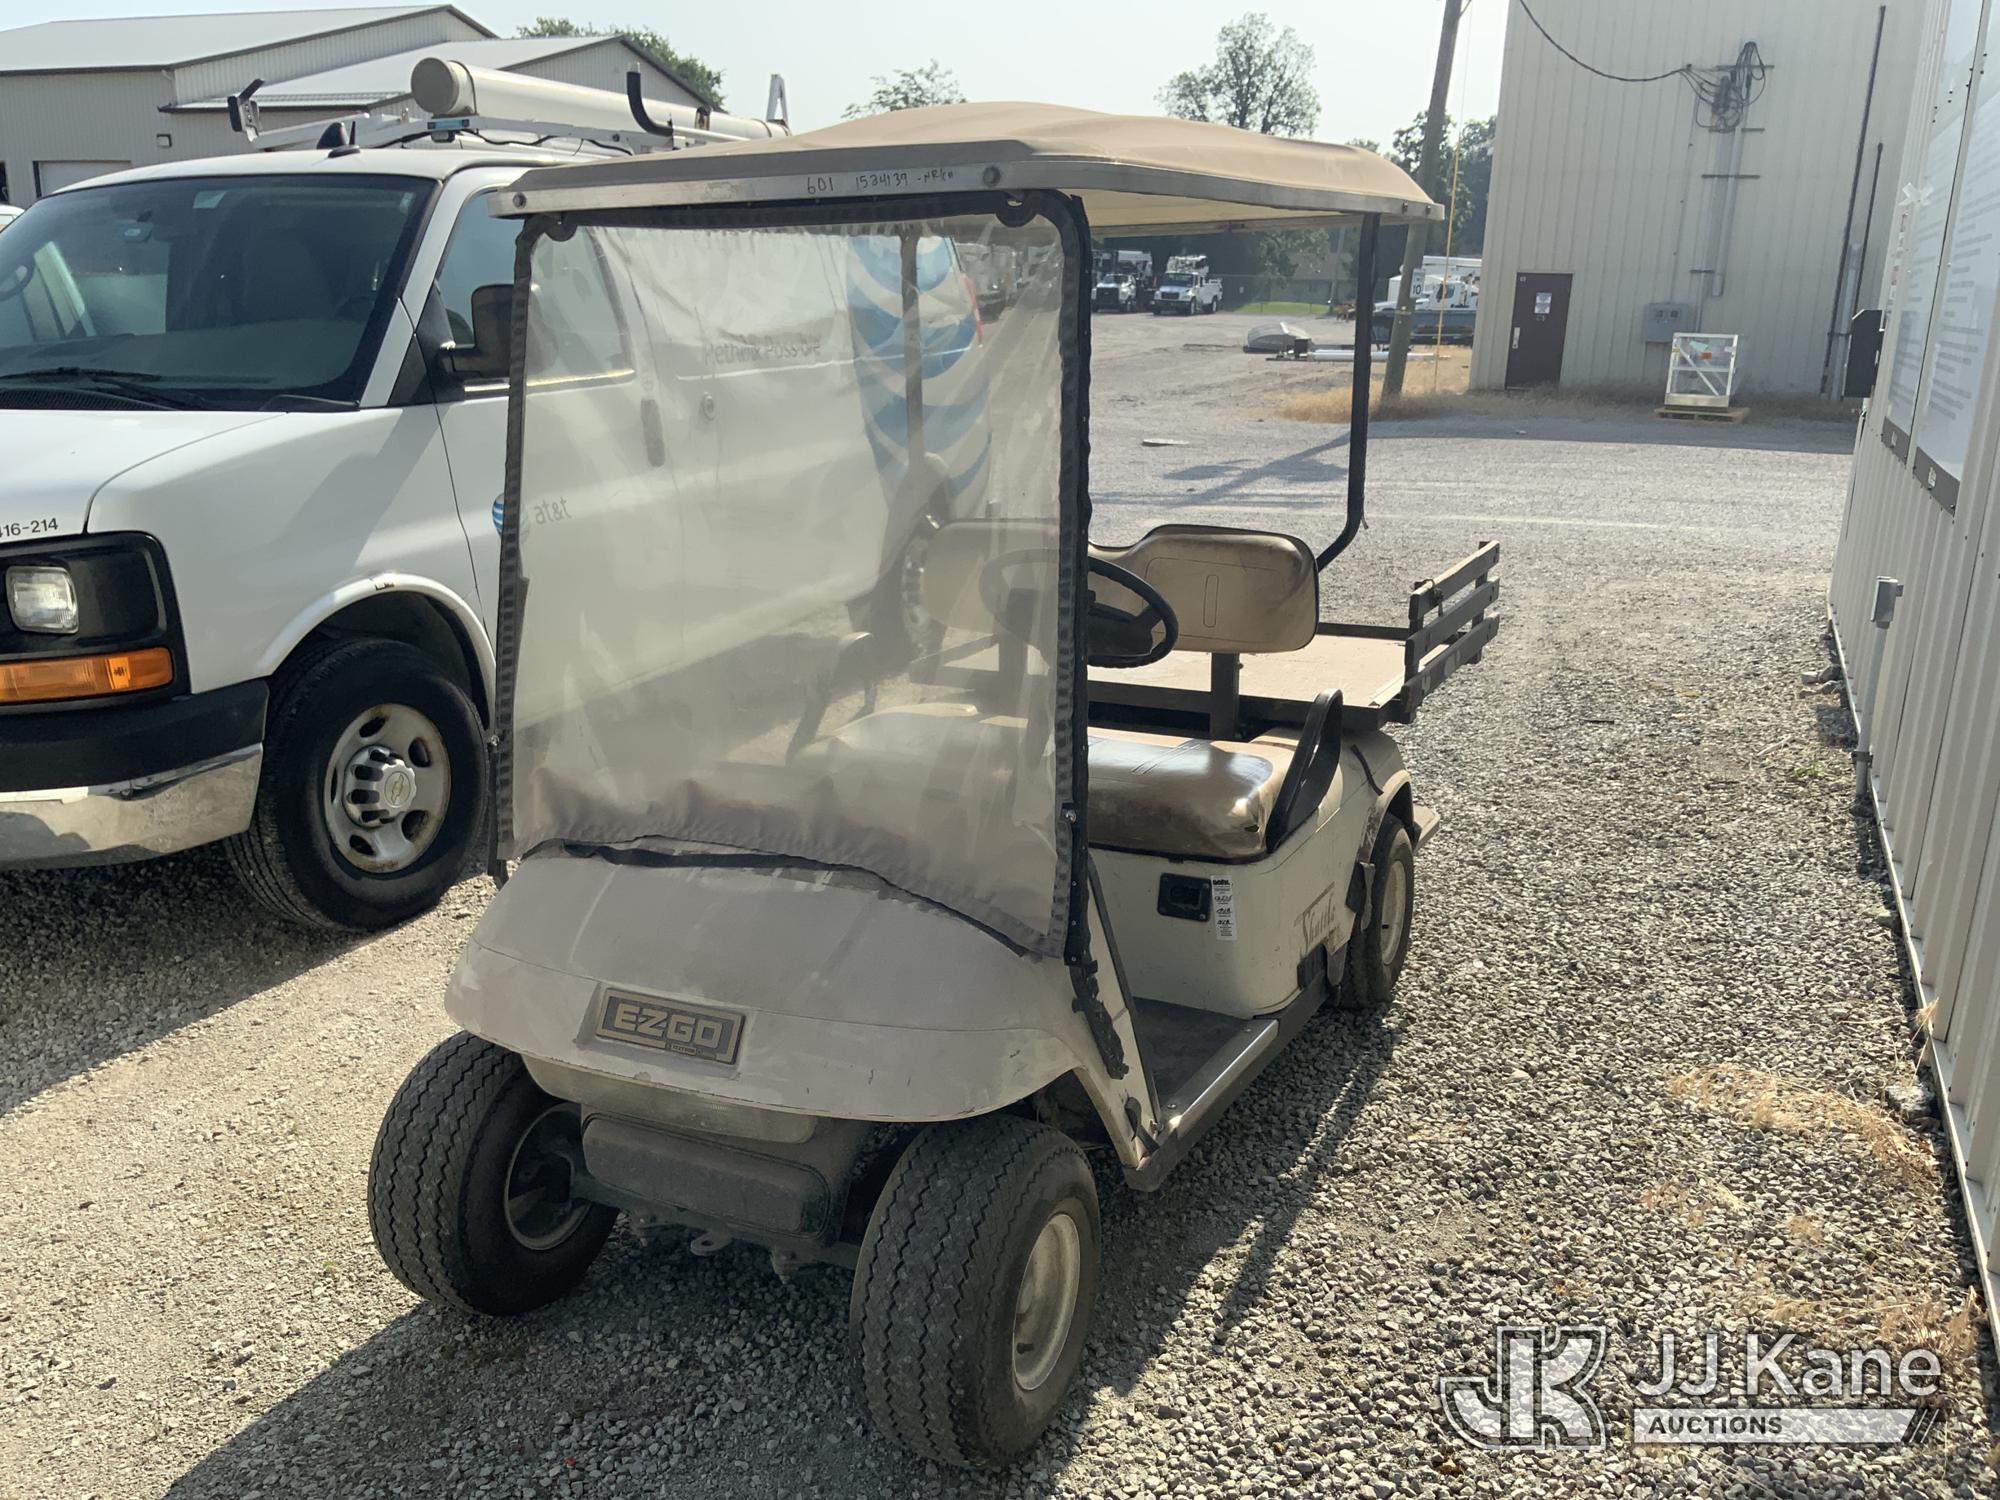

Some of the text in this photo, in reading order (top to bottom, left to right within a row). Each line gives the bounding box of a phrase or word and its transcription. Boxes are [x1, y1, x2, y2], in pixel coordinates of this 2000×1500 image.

[807, 176, 834, 195] 601
[533, 496, 573, 526] at&t
[613, 1002, 724, 1050] EZGO
